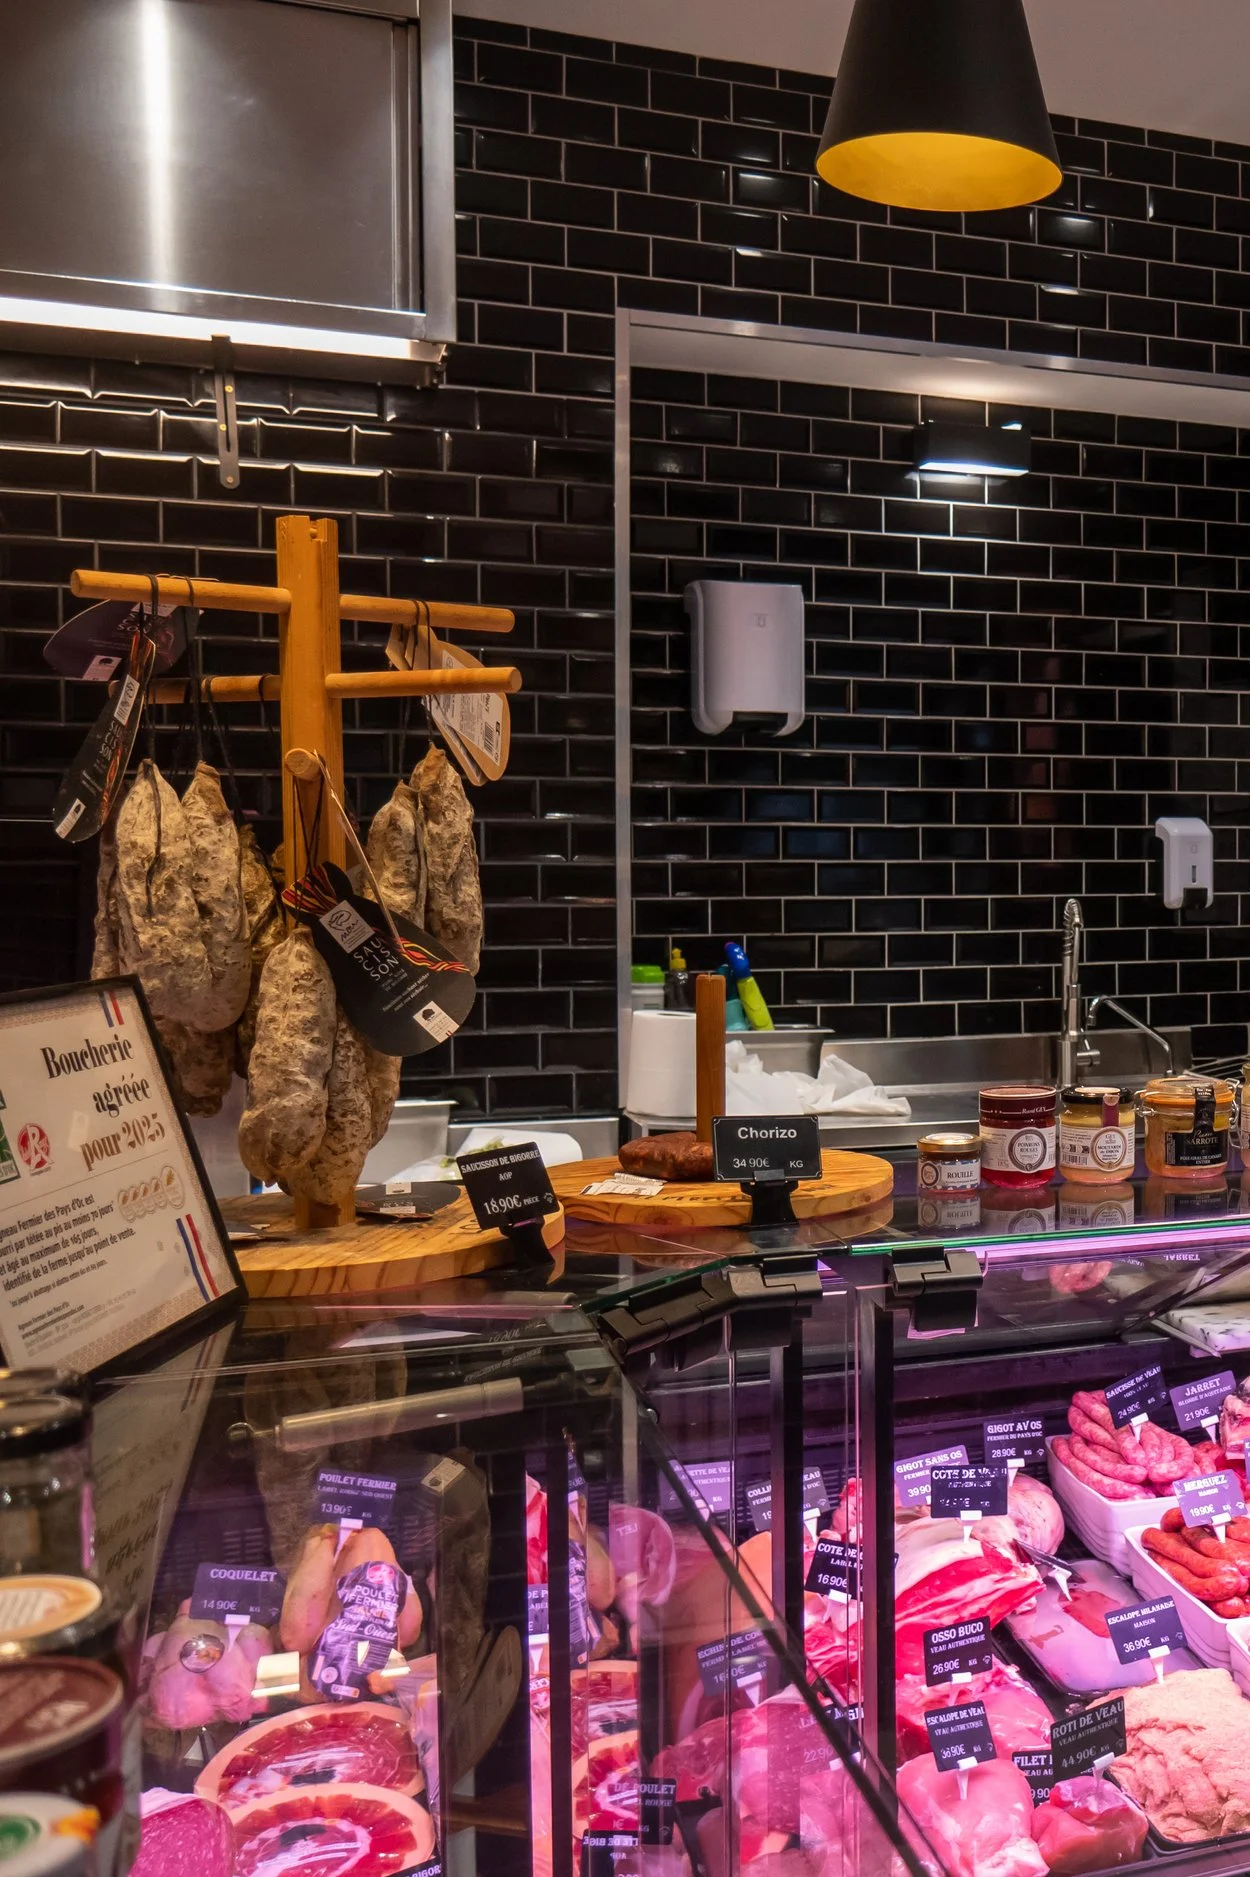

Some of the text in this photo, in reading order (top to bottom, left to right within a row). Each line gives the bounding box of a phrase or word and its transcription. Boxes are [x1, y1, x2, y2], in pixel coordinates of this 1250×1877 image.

[40, 1034, 134, 1079] Boucherie
[92, 1073, 151, 1118] agréée
[737, 1126, 798, 1139] Chorizo
[80, 1113, 166, 1172] pour 2025
[461, 1149, 540, 1174] SAUCISSON DE BIGORRE
[789, 1160, 804, 1169] KG
[499, 1171, 513, 1182] AOP
[947, 1171, 973, 1179] ROUILLE
[18, 1214, 43, 1232] Fermier
[44, 1209, 56, 1221] des
[55, 1203, 72, 1217] Pays
[14, 1239, 26, 1253] par
[44, 1228, 53, 1239] au
[53, 1222, 63, 1238] pis
[63, 1220, 72, 1231] au
[72, 1213, 91, 1227] moins
[20, 1256, 29, 1267] au
[29, 1242, 61, 1262] maximum
[61, 1236, 70, 1249] de
[32, 1266, 42, 1279] de
[41, 1263, 49, 1275] la
[48, 1255, 69, 1272] ferme
[109, 1232, 118, 1244] de
[1106, 1366, 1161, 1399] SAUCISSE DE VEAU
[1185, 1378, 1221, 1397] JARRET
[986, 1420, 1043, 1434] GIGOT AV OS
[896, 1450, 963, 1474] GIGOT SANS OS
[320, 1472, 397, 1491] POULET FERMIER
[962, 1469, 976, 1479] DE
[1184, 1474, 1228, 1492] MERGUEZ
[818, 1542, 844, 1556] COTE
[210, 1568, 278, 1582] COQUELET
[354, 1584, 399, 1603] POULET
[1108, 1600, 1175, 1625] ESCALOPE MILANAISE
[932, 1622, 984, 1644] OSSO BUCO
[930, 1634, 986, 1654] VEAU AUTHENTIQUE
[926, 1710, 969, 1726] ESCALOPE DE
[1052, 1700, 1124, 1739] ROTI DE VEAU
[1059, 1717, 1119, 1746] VEAU AUTHENTIQUE
[1014, 1754, 1047, 1767] FILET
[633, 1784, 676, 1794] POULET
